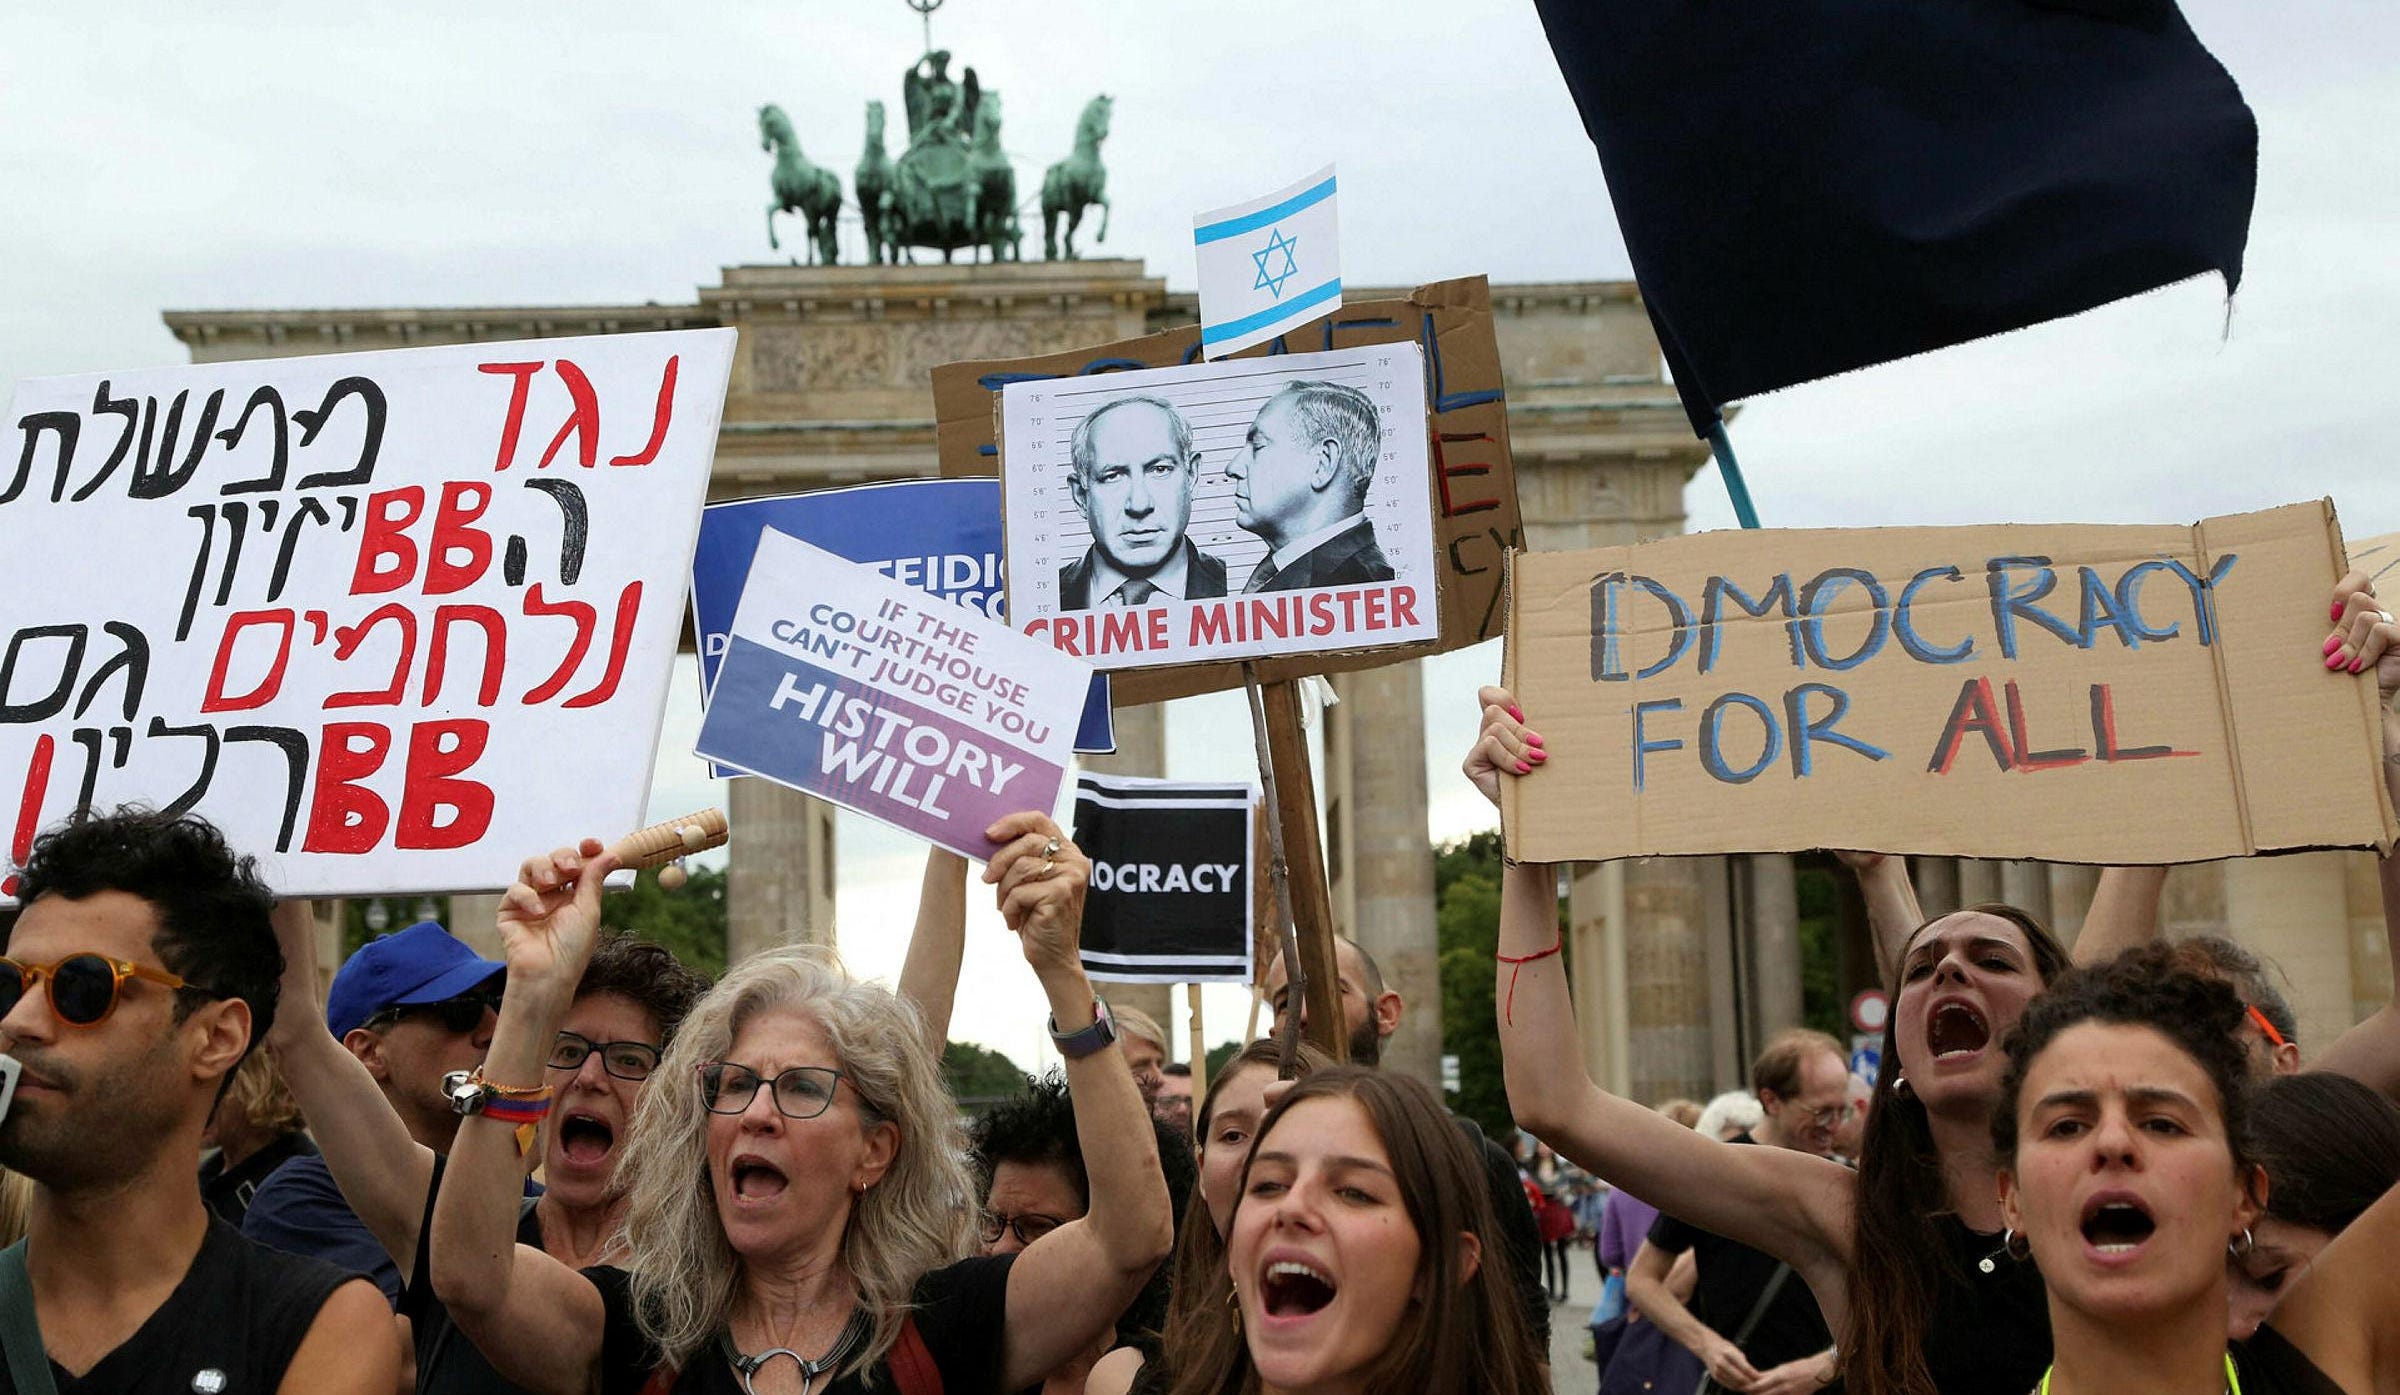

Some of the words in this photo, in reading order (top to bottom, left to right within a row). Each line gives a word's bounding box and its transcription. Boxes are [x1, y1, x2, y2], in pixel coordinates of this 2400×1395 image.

[1, 375, 388, 503] ממשלת
[477, 354, 679, 472] נגד
[0, 620, 150, 723] גם
[200, 580, 644, 714] נלחמים
[809, 603, 1030, 707] COURTHOUSE
[877, 597, 908, 622] IF
[917, 611, 980, 654] THE
[1188, 585, 1421, 647] MINISTER
[1589, 553, 2239, 682] DMOCRACY
[769, 672, 1025, 796] HISTORY
[771, 619, 871, 669] CAN'T
[870, 657, 975, 713] JUDGE
[982, 701, 1051, 744] YOU
[1626, 681, 1893, 795] FOR
[1926, 675, 2201, 777] ALL
[820, 731, 952, 821] WILL
